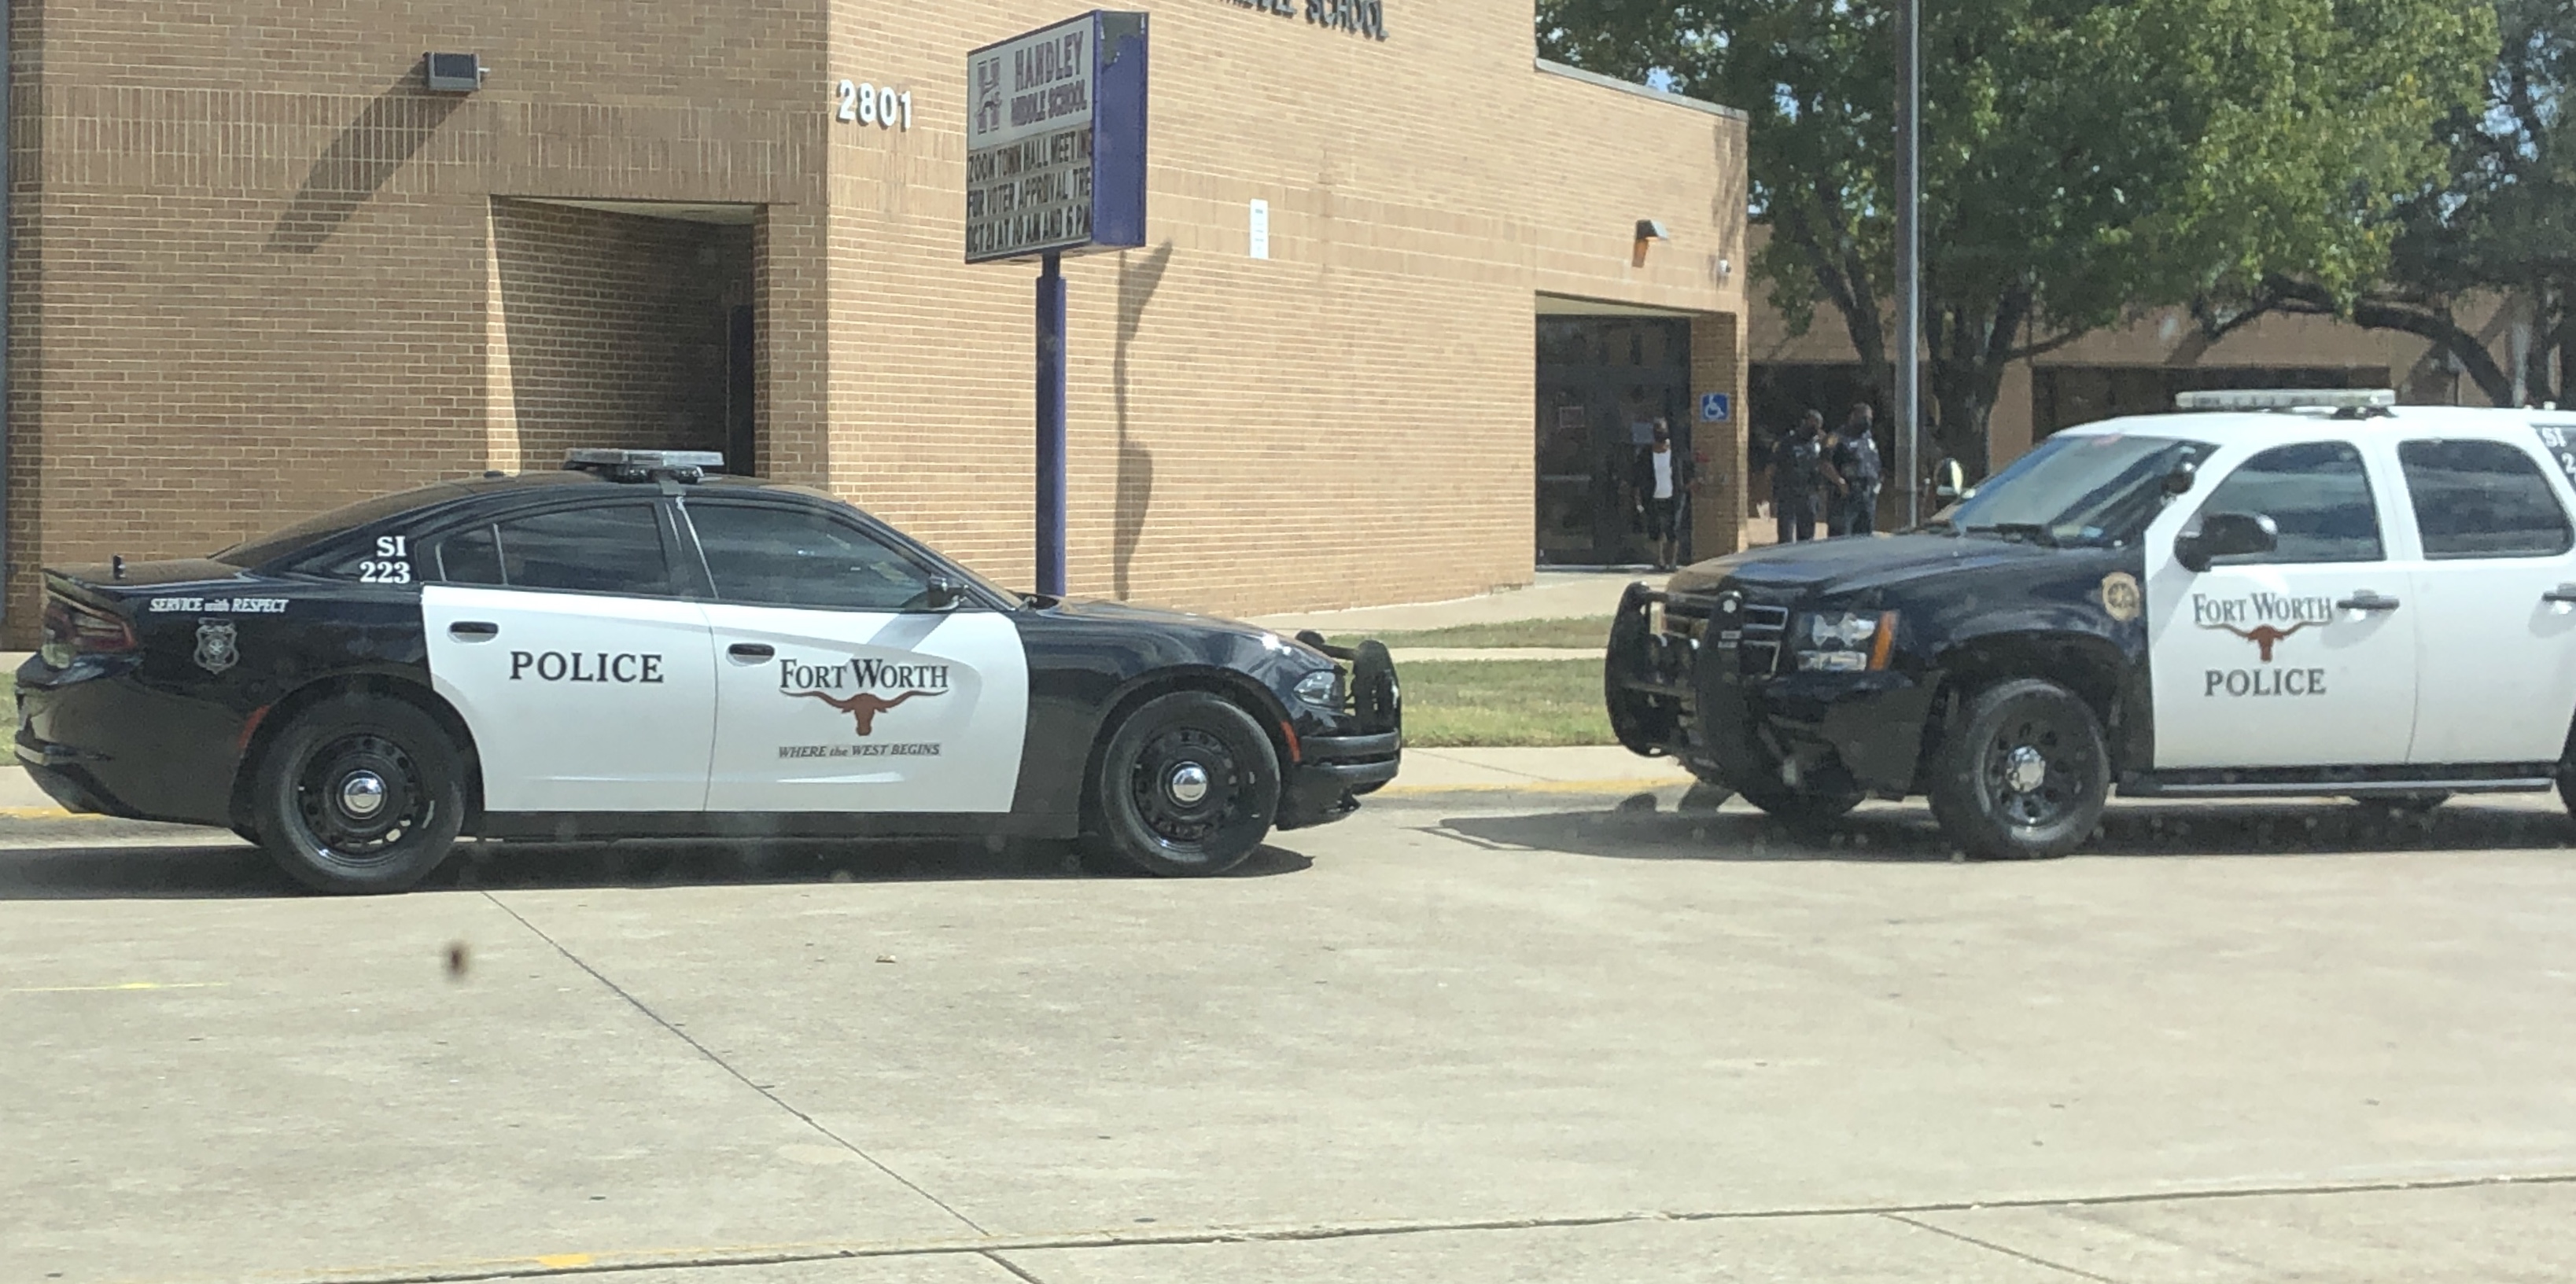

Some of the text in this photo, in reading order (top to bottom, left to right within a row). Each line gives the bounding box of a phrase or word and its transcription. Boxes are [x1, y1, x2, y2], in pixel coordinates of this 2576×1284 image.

[1015, 31, 1084, 92] HANDLEY
[837, 79, 912, 131] 2801
[1011, 79, 1087, 127] MIDDLE SCHOOL
[968, 152, 995, 182] ZOOM
[997, 145, 1022, 179] TOWN
[1023, 137, 1048, 171] HALL
[967, 189, 984, 219] FOR
[986, 182, 1015, 215] VOTER
[1019, 170, 1068, 207] APPROVAL
[997, 218, 1010, 248] AT
[1043, 208, 1062, 241] AND
[1066, 204, 1074, 237] 6
[2541, 427, 2567, 447] SI
[376, 535, 407, 557] SI
[359, 561, 411, 584] 223
[149, 597, 289, 613] SERVICE with RESPECT
[2192, 592, 2333, 623] FORT WORTH
[510, 650, 664, 683] POLICE
[776, 657, 949, 689] FORT WORTH
[2204, 668, 2327, 697] POLICE
[778, 743, 941, 758] WHERE the WEST BEGINS
